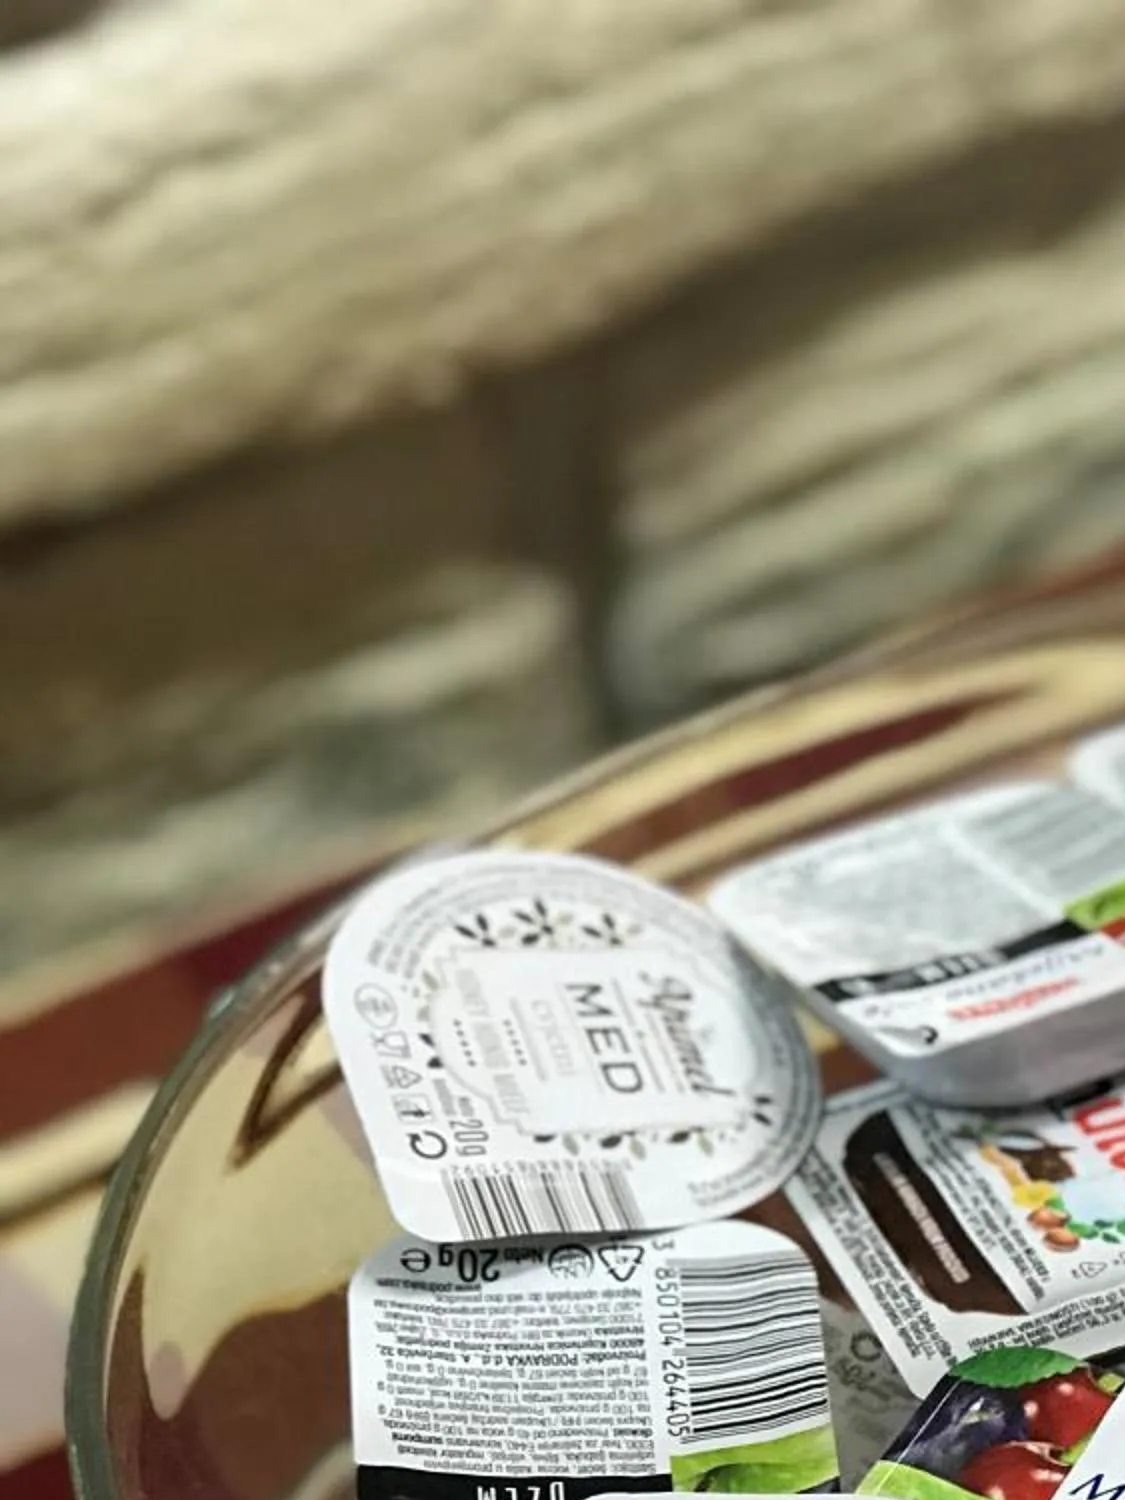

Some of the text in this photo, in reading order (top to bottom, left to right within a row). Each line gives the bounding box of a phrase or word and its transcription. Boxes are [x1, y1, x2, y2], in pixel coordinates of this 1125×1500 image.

[563, 981, 646, 1095] MED
[438, 1248, 501, 1282] 20g
[654, 1268, 678, 1348] 850104
[662, 1358, 692, 1438] 264405
